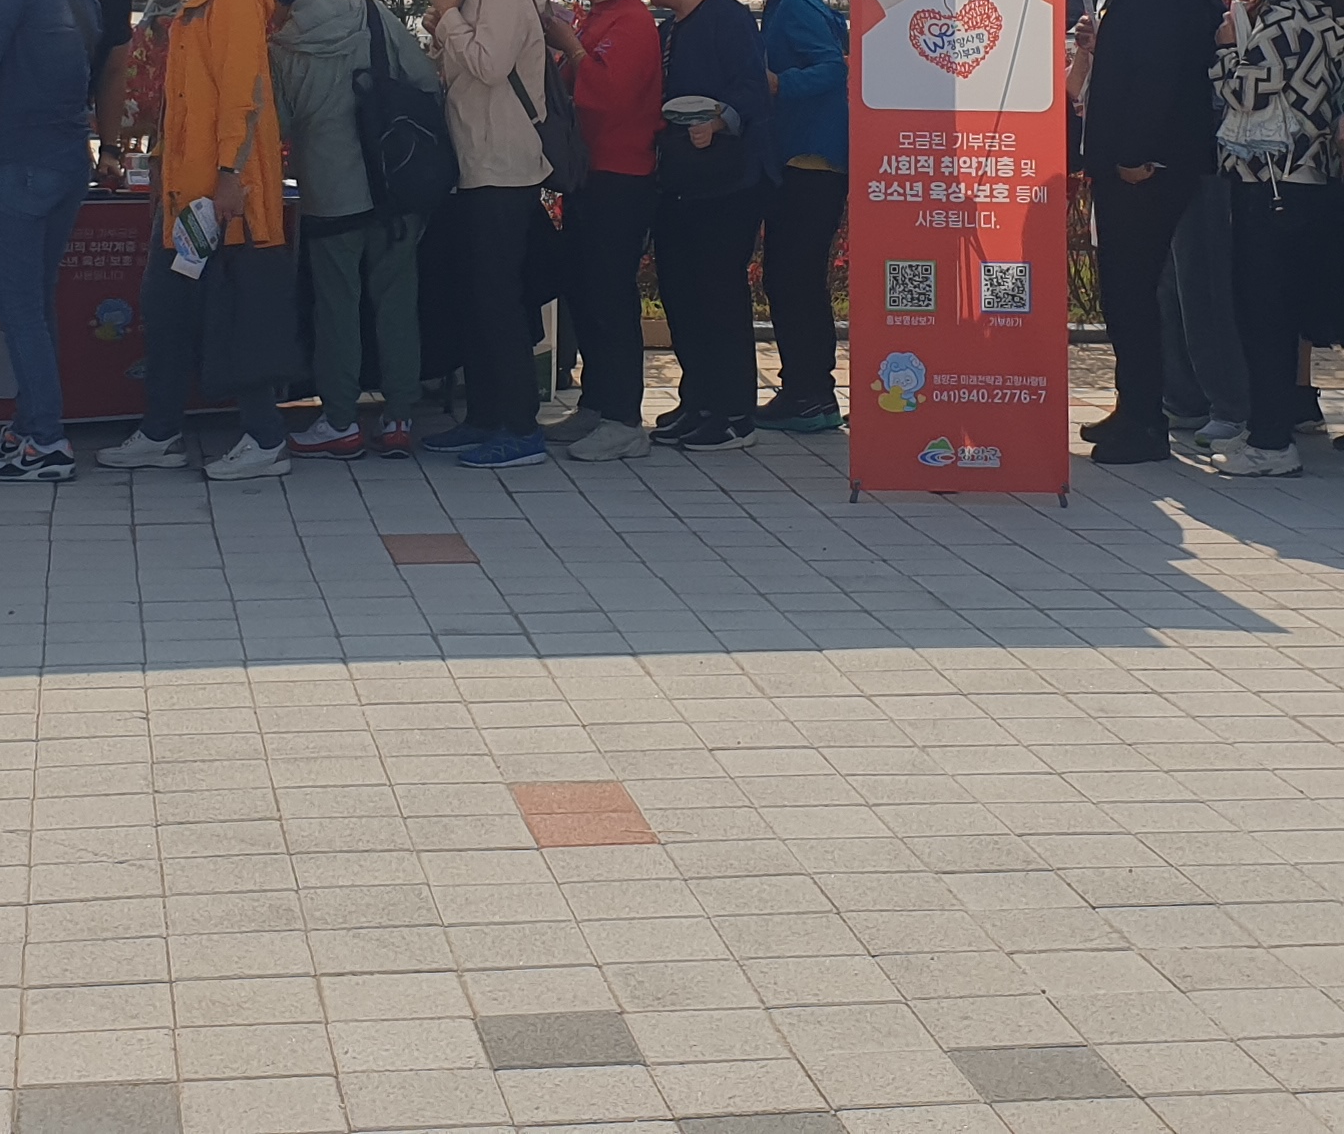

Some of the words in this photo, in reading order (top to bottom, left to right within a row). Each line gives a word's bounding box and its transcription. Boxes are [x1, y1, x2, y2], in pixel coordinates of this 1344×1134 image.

[899, 131, 946, 150] 모금된
[952, 132, 1016, 151] 기부금은
[878, 155, 934, 177] 사회적
[940, 156, 1015, 178] 취약계층
[1020, 160, 1036, 178] 및
[867, 181, 923, 202] 청소년
[1015, 185, 1048, 204] 등에
[914, 210, 1000, 229] 사용됩니다.
